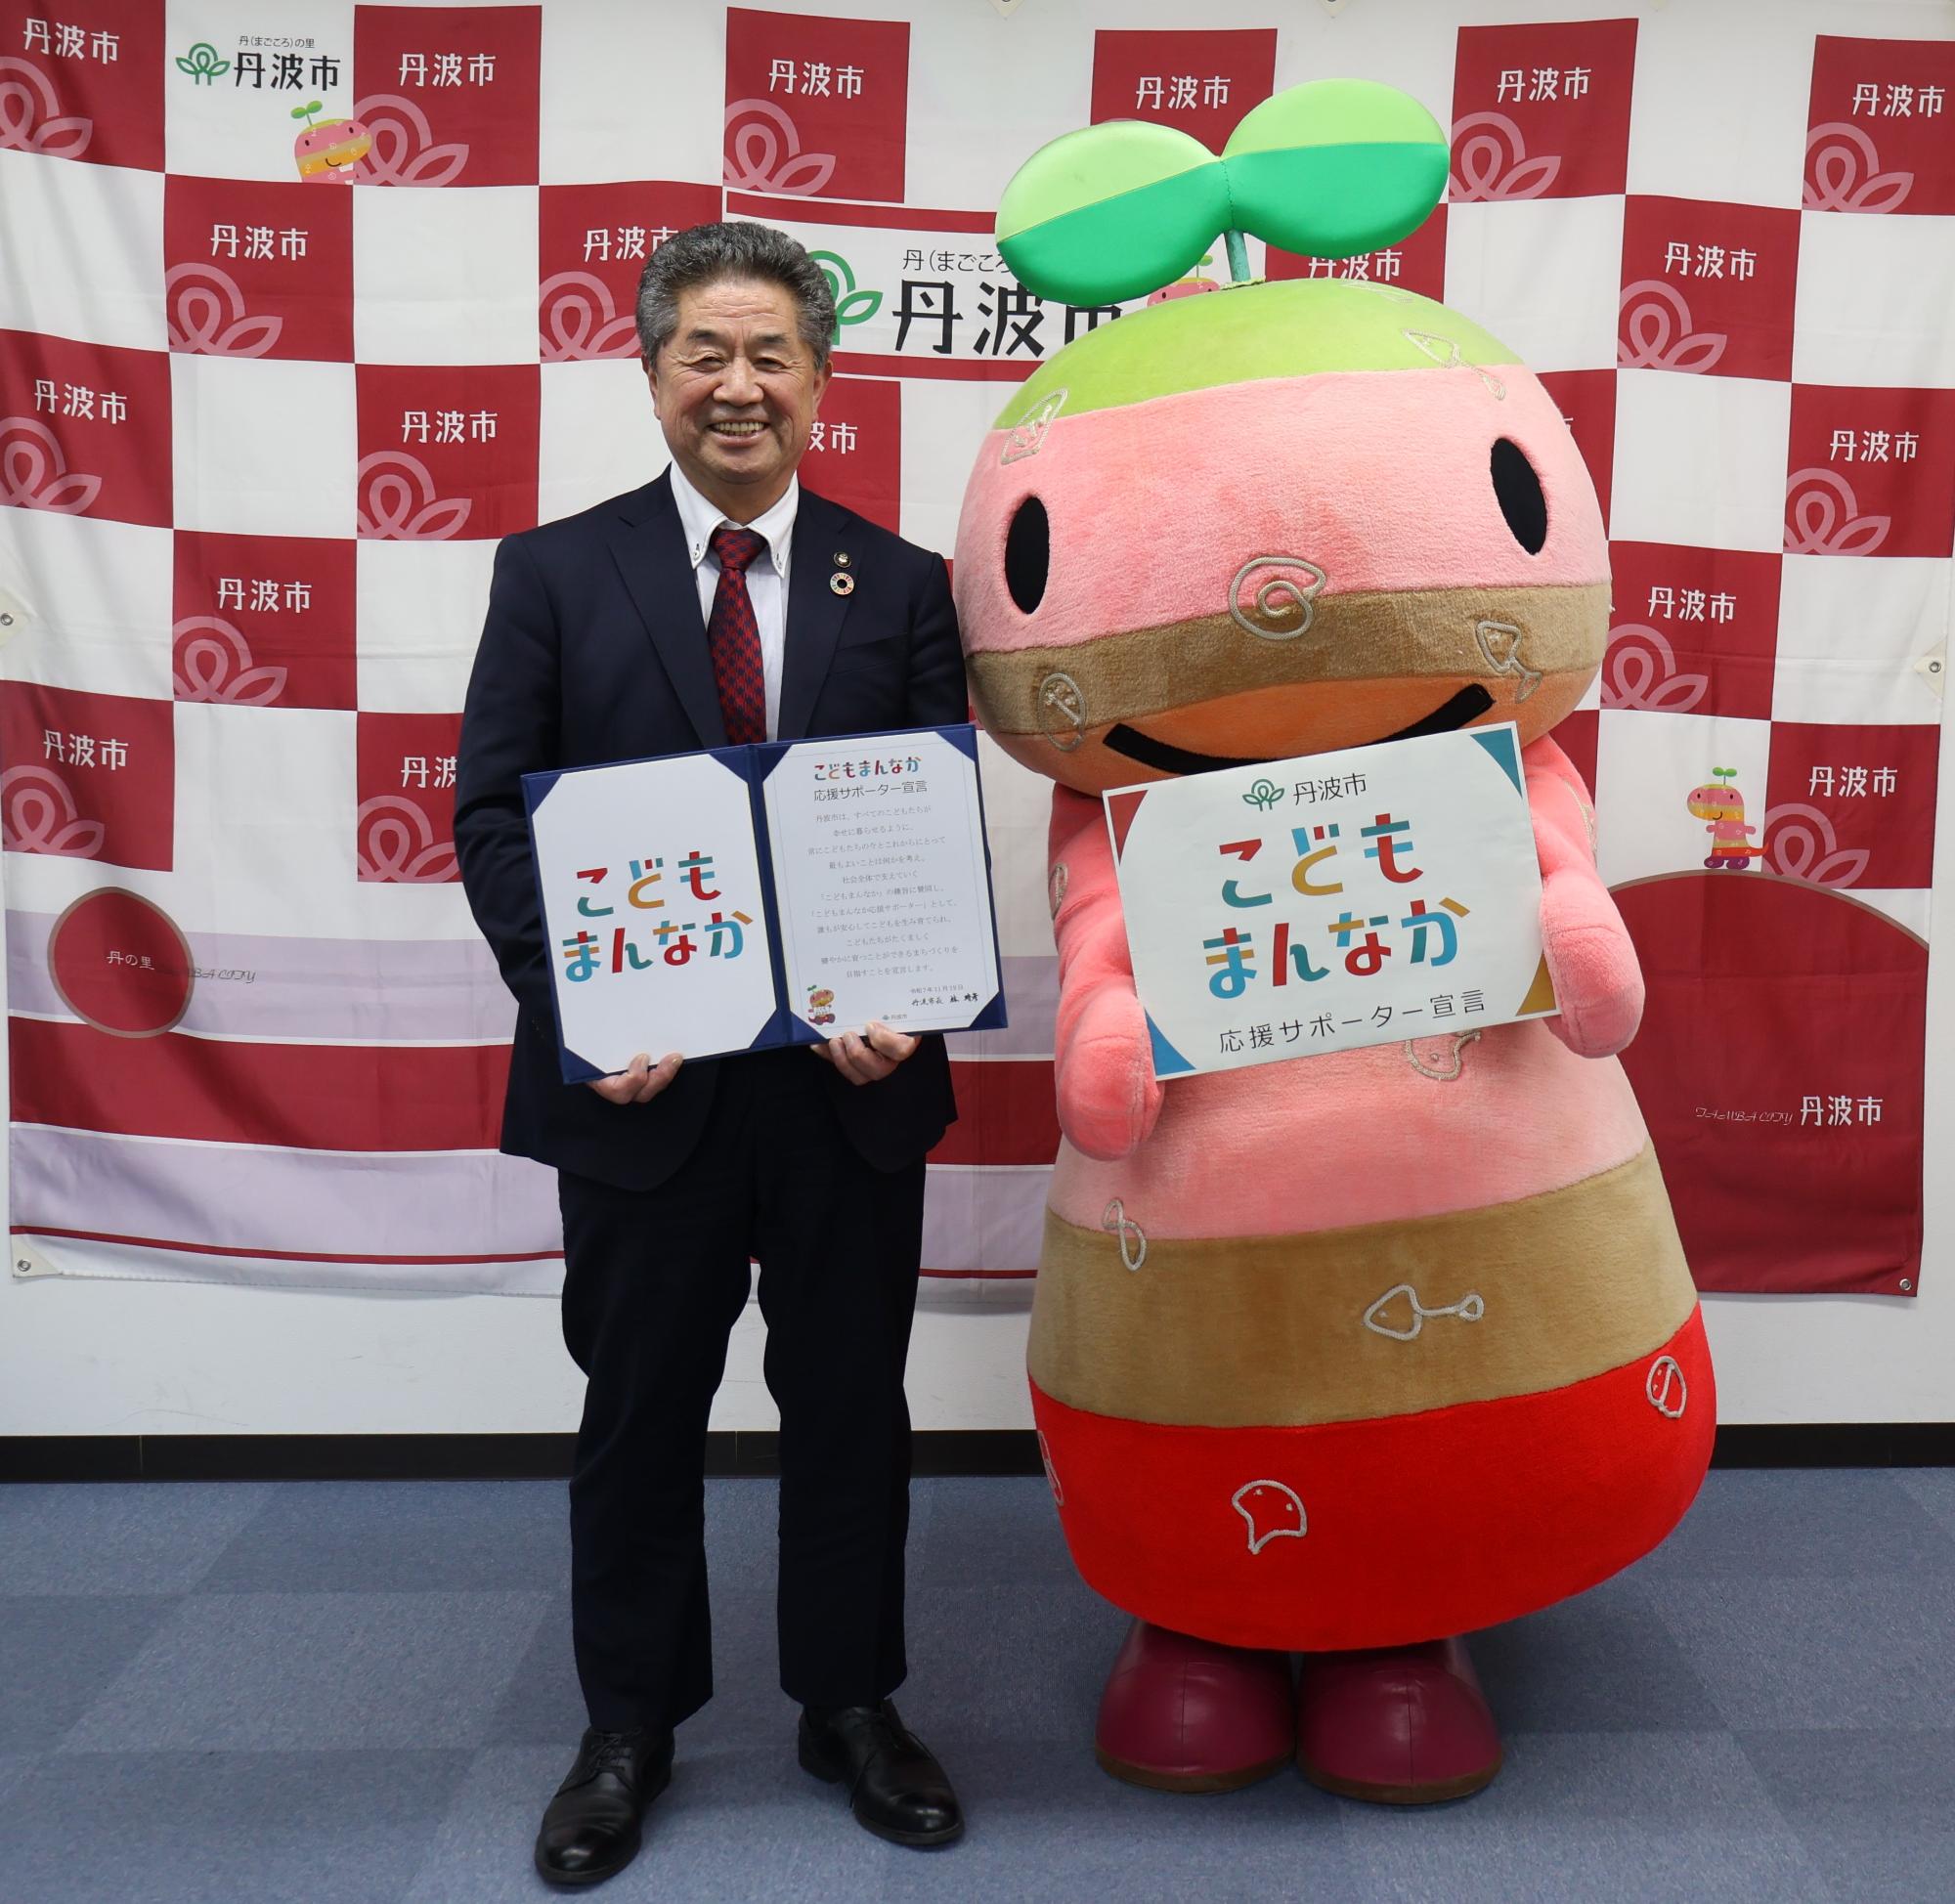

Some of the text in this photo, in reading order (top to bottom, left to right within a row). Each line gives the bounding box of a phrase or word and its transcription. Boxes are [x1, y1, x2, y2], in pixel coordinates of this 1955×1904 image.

[23, 19, 119, 64] 丹波市
[239, 36, 315, 49] 丹(まごころ)の里
[234, 52, 341, 91] 丹波市
[399, 53, 497, 87] 丹波市
[768, 60, 864, 100] 丹波市
[1498, 67, 1591, 103] 丹波市
[1136, 76, 1232, 109] 丹波市
[1852, 83, 1945, 118] 丹波市
[211, 224, 309, 261] 丹波市
[1665, 241, 1757, 281] 丹波市
[34, 379, 127, 425] 丹波市
[401, 411, 498, 444] 丹波市
[1830, 430, 1920, 463] 丹波市
[218, 578, 312, 614] 丹波市
[1647, 586, 1737, 624] 丹波市
[44, 730, 129, 771] 丹波市
[813, 757, 922, 782] こどもまんなか
[1808, 766, 1898, 798] 丹波市
[813, 780, 928, 802] 応援サポーター宣言
[1293, 773, 1367, 805] 丹波市
[1218, 812, 1424, 909] こども
[577, 850, 721, 918] こども
[107, 950, 154, 971] 丹の里
[562, 910, 754, 982] まんなか
[1202, 896, 1471, 1000] まんなか
[1219, 988, 1485, 1056] 応援サポーター宣言
[1800, 1095, 1884, 1126] 丹波市
